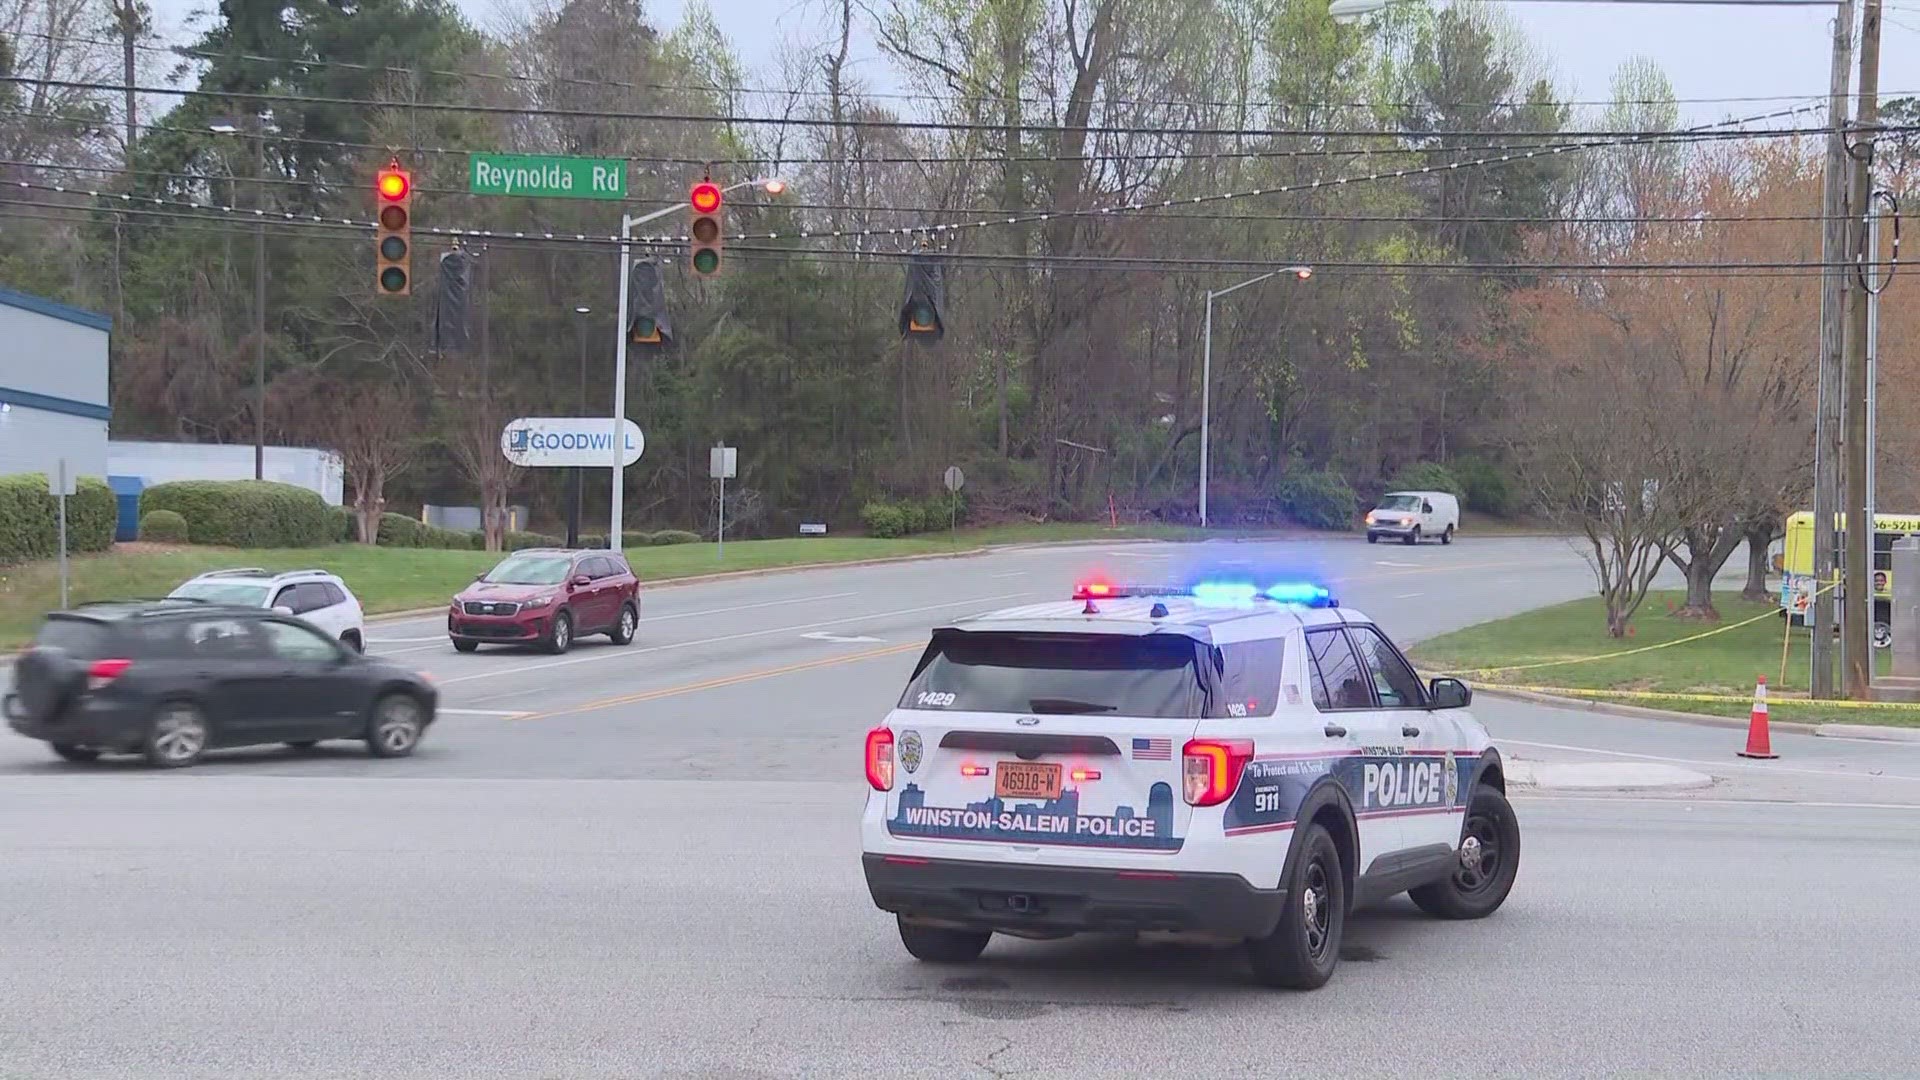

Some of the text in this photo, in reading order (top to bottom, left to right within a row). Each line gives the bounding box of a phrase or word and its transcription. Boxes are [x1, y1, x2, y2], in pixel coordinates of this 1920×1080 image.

[476, 160, 619, 193] Reynolda Rd
[531, 433, 635, 450] GOODWIL
[917, 691, 956, 706] 1429
[1227, 703, 1247, 717] 1429
[1262, 762, 1287, 777] Protect
[1002, 771, 1054, 792] 46918-W
[1363, 761, 1440, 808] POLICE
[1255, 793, 1279, 812] 911
[905, 807, 1156, 838] WINSTON-SALEM POLICE
